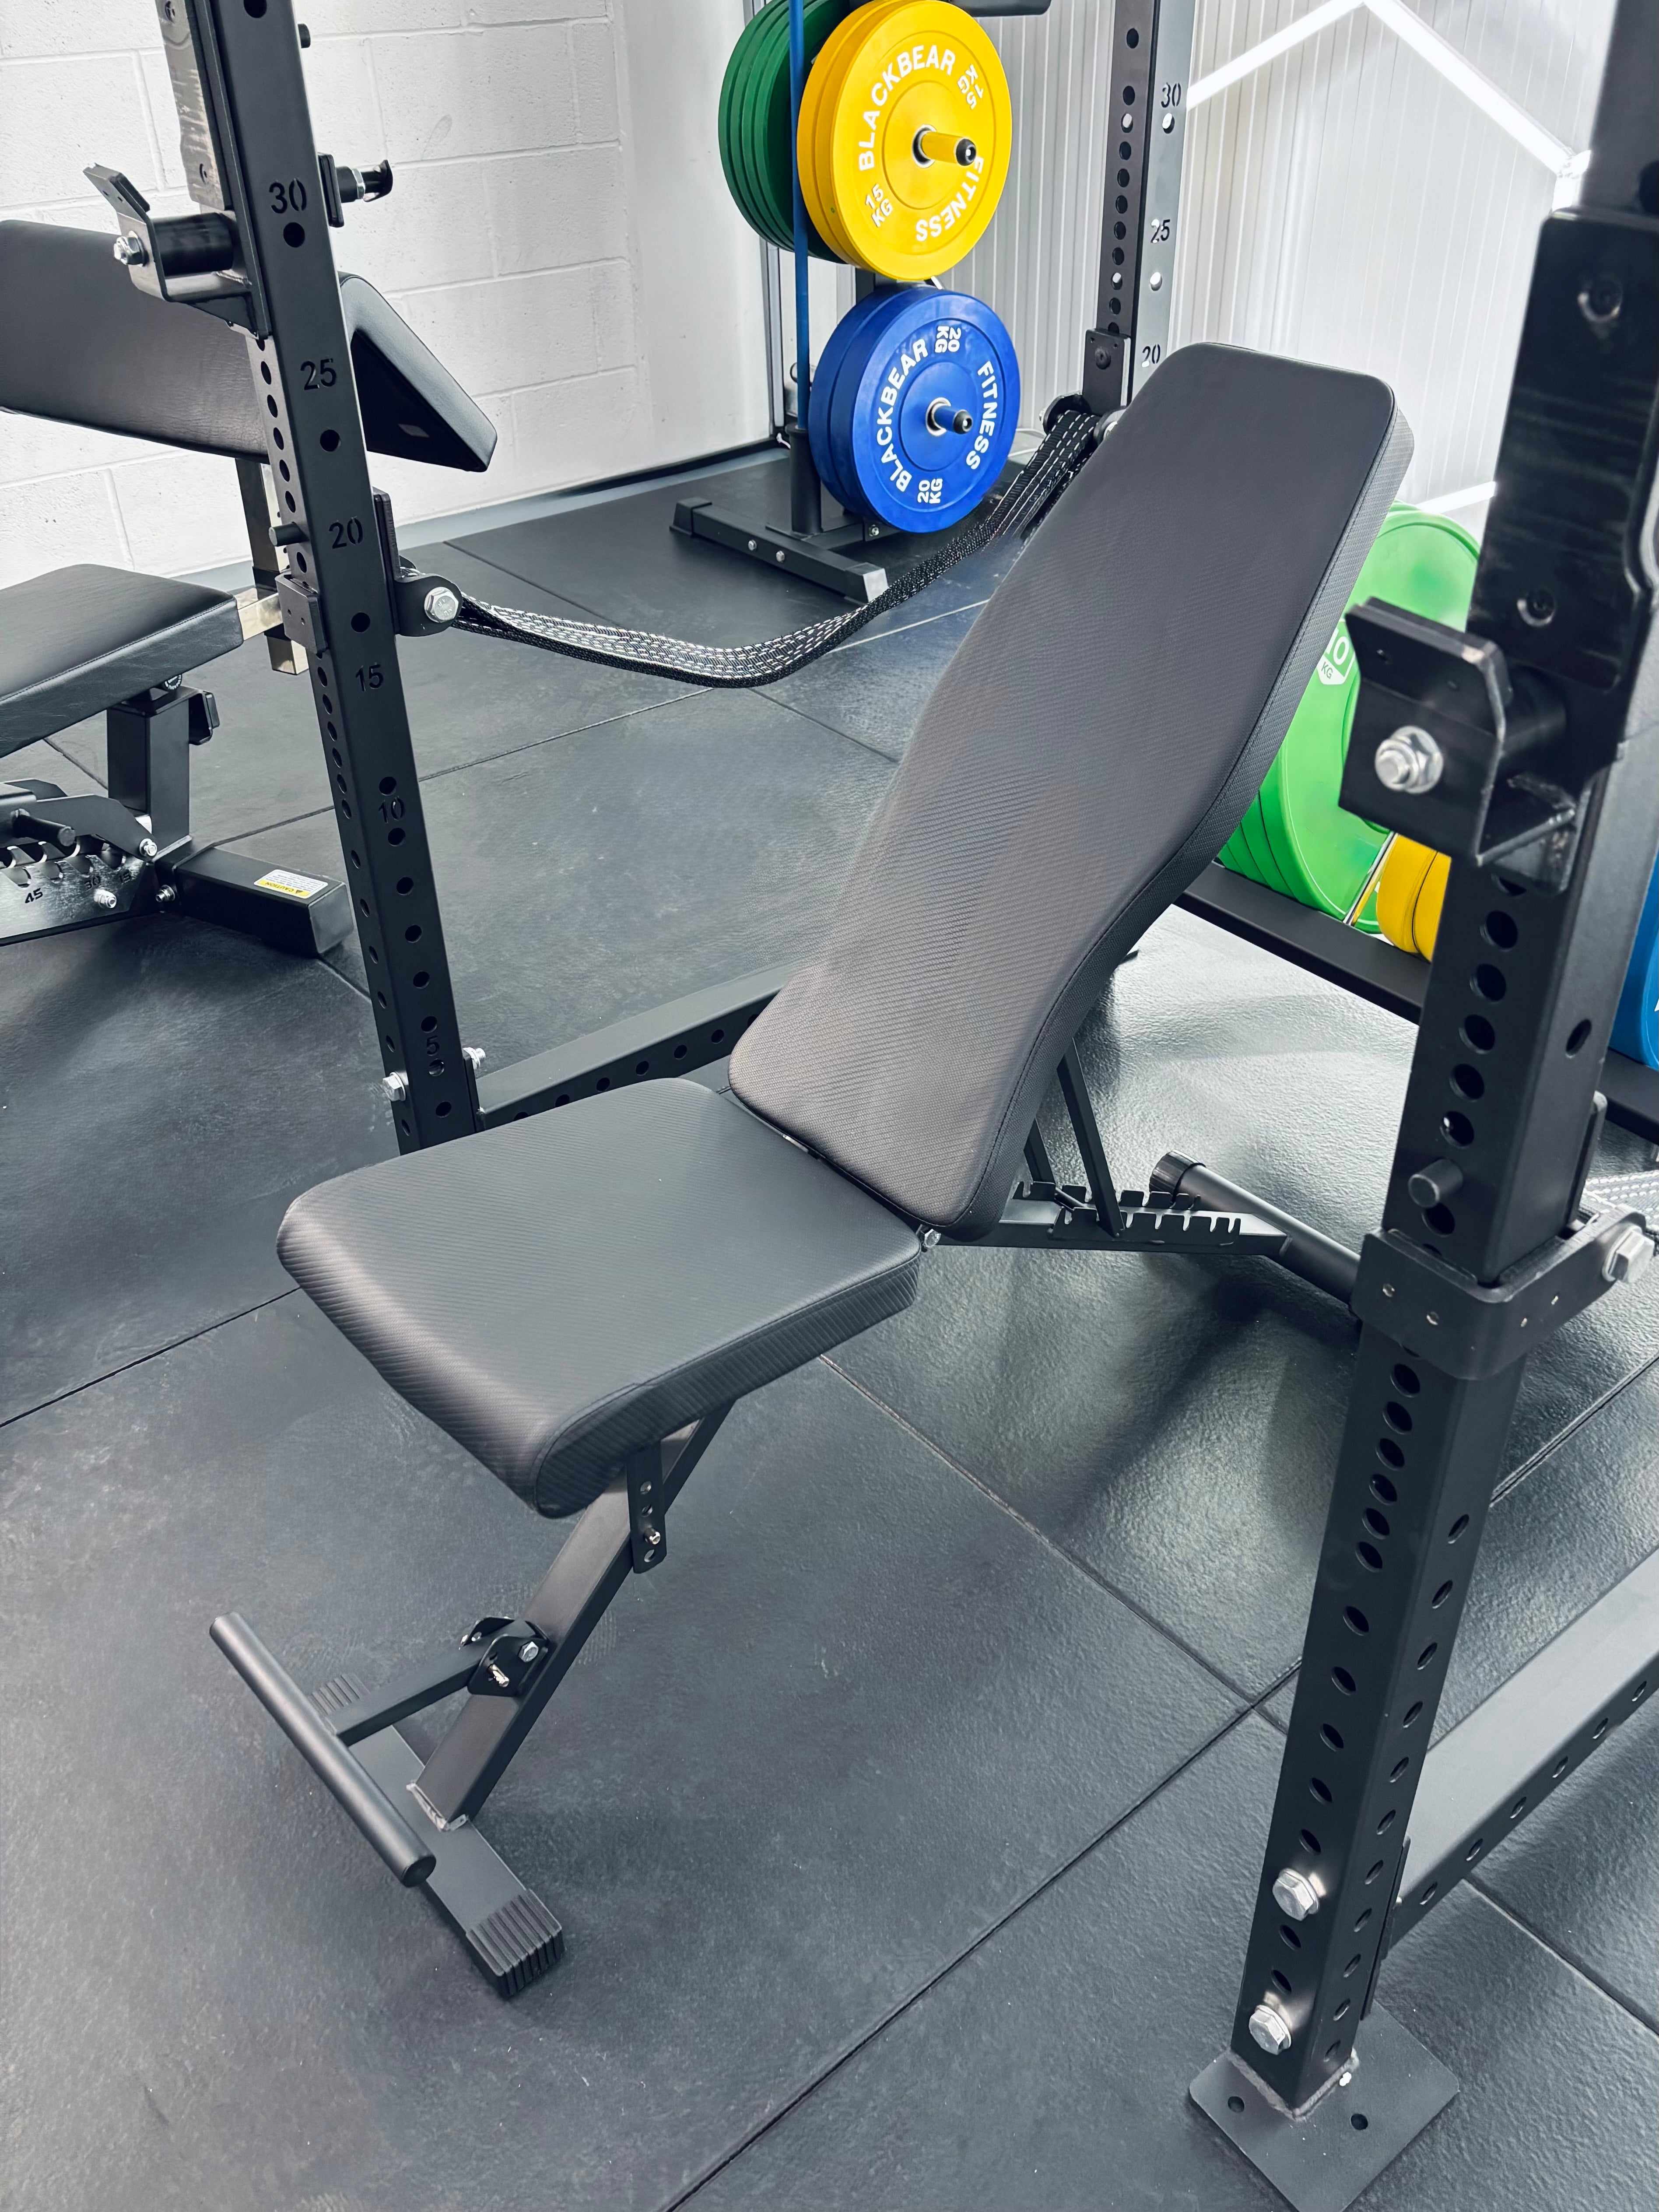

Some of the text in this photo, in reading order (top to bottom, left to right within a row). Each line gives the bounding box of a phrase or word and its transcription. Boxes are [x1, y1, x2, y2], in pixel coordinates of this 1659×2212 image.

[957, 64, 979, 94] KG
[858, 45, 955, 171] BLACKBEAR
[966, 84, 984, 110] 15
[1161, 82, 1181, 108] 30
[269, 179, 307, 214] 30
[866, 184, 884, 209] 15
[916, 157, 984, 242] FITNESS
[872, 198, 893, 227] KG
[1150, 219, 1170, 243] 25
[935, 326, 949, 353] KG
[948, 327, 961, 352] 20
[1142, 344, 1161, 367] 20
[300, 358, 337, 390] 25
[877, 339, 928, 492] BLACKBEAR
[966, 361, 998, 470] FITNESS
[917, 480, 930, 503] 20
[929, 478, 943, 504] KG
[329, 518, 363, 549] 20
[355, 664, 383, 692] 15
[1321, 661, 1333, 679] KG
[378, 796, 405, 823] 10
[25, 888, 43, 903] 45
[84, 876, 101, 889] 30
[265, 882, 295, 892] CAUTION
[427, 1036, 439, 1056] 5
